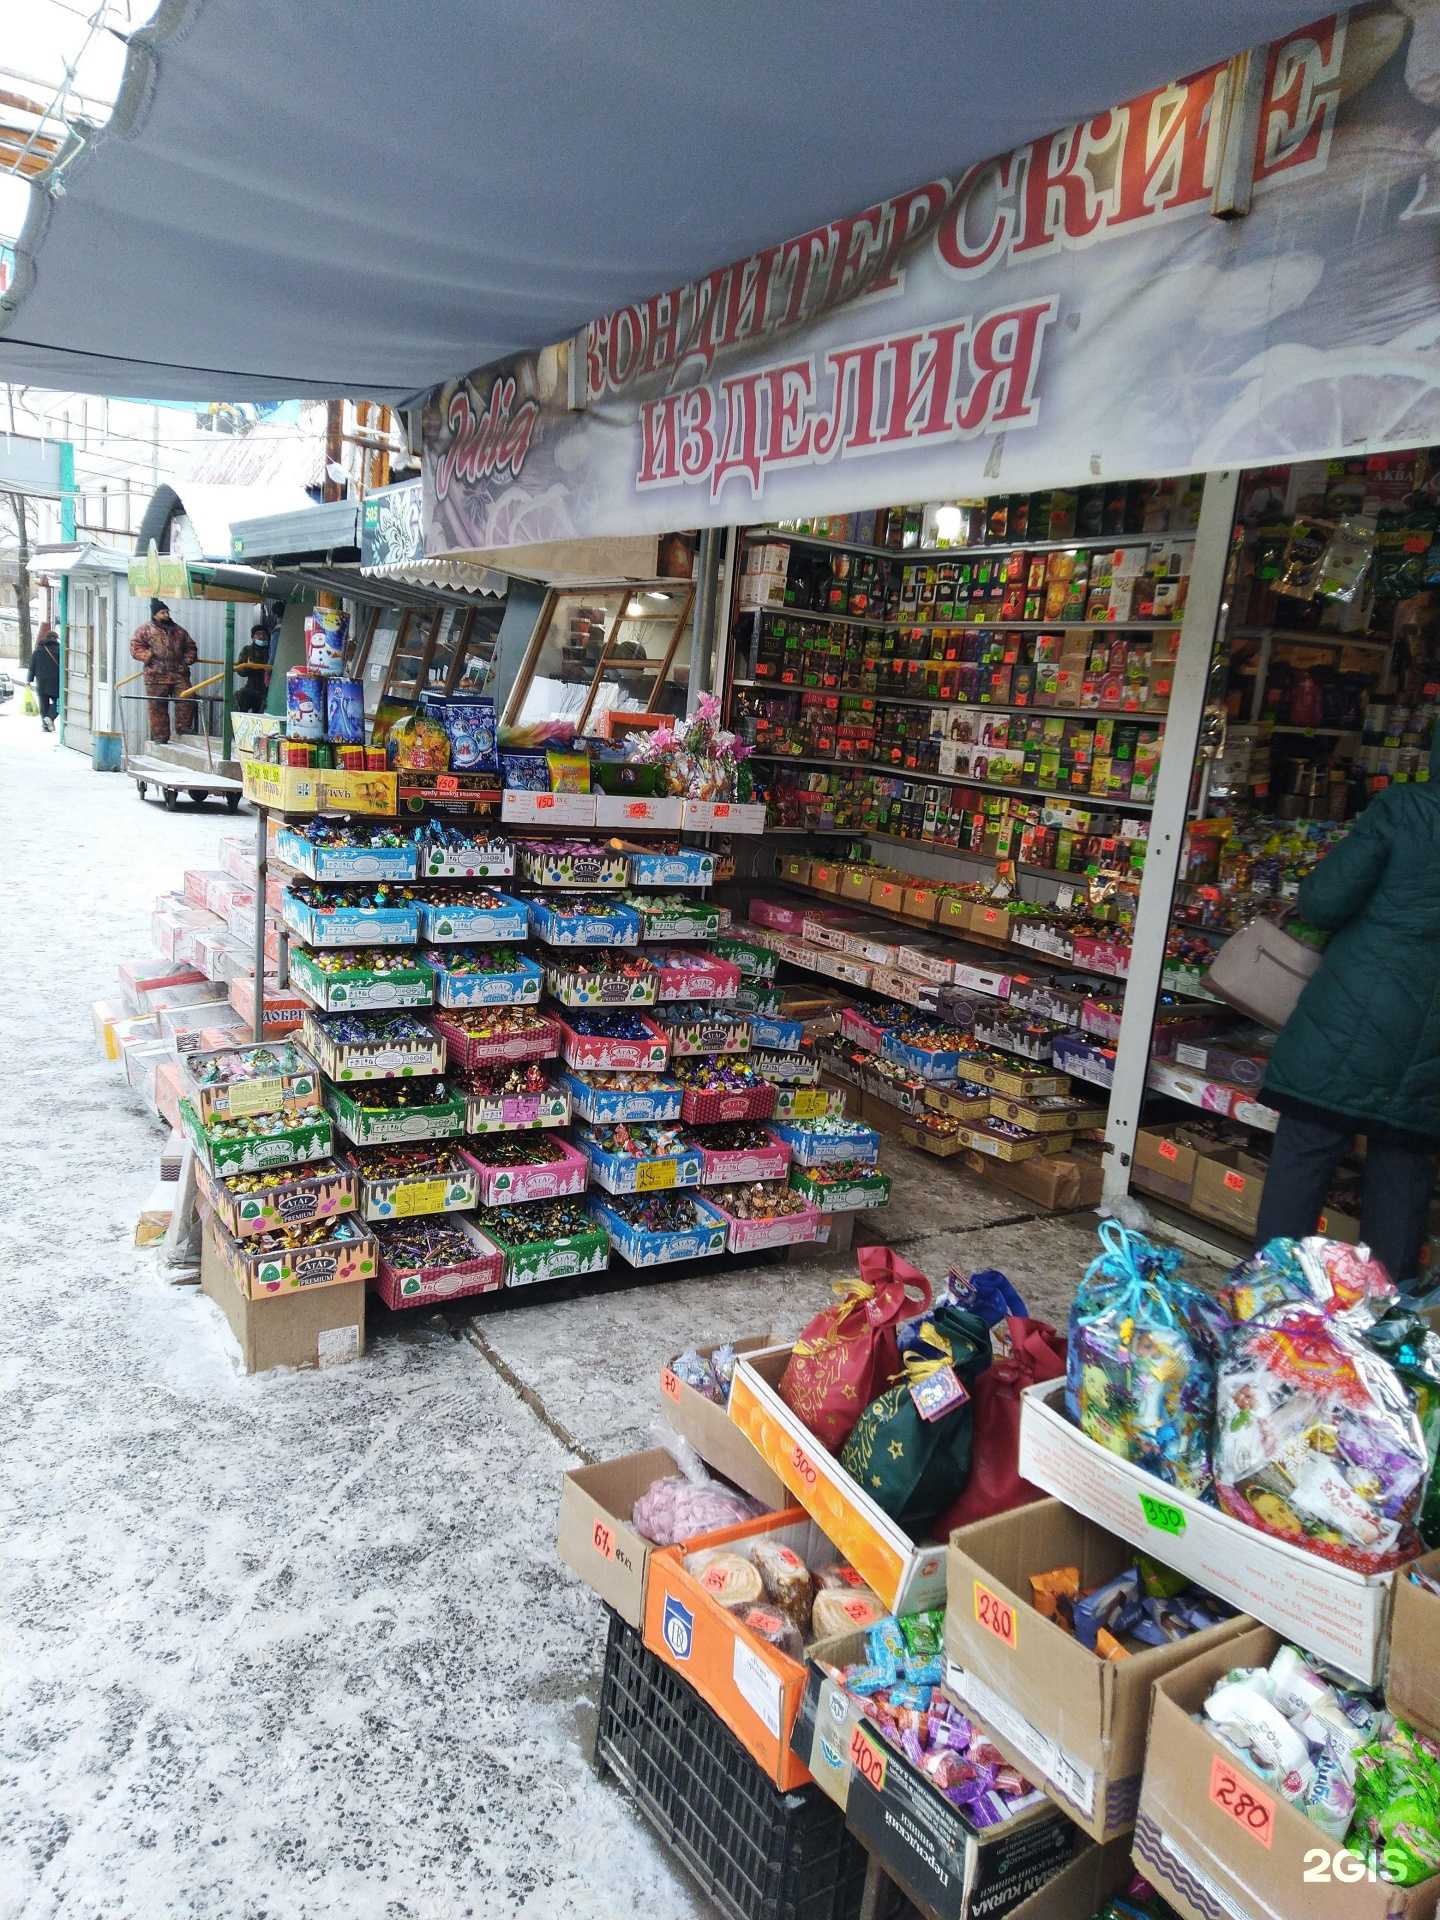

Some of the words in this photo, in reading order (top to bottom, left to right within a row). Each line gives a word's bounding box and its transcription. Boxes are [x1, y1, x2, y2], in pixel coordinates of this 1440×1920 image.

[586, 13, 1346, 400] КОНДИТЕРСКИЕ
[636, 296, 1057, 503] ИЗДЕЛИЯ
[436, 377, 538, 500] Julia
[792, 1447, 817, 1483] 300
[1148, 1501, 1181, 1527] 350
[979, 1594, 1011, 1638] 280
[851, 1730, 883, 1786] 400
[1216, 1776, 1269, 1828] 280
[972, 1883, 1021, 1917] KURMA
